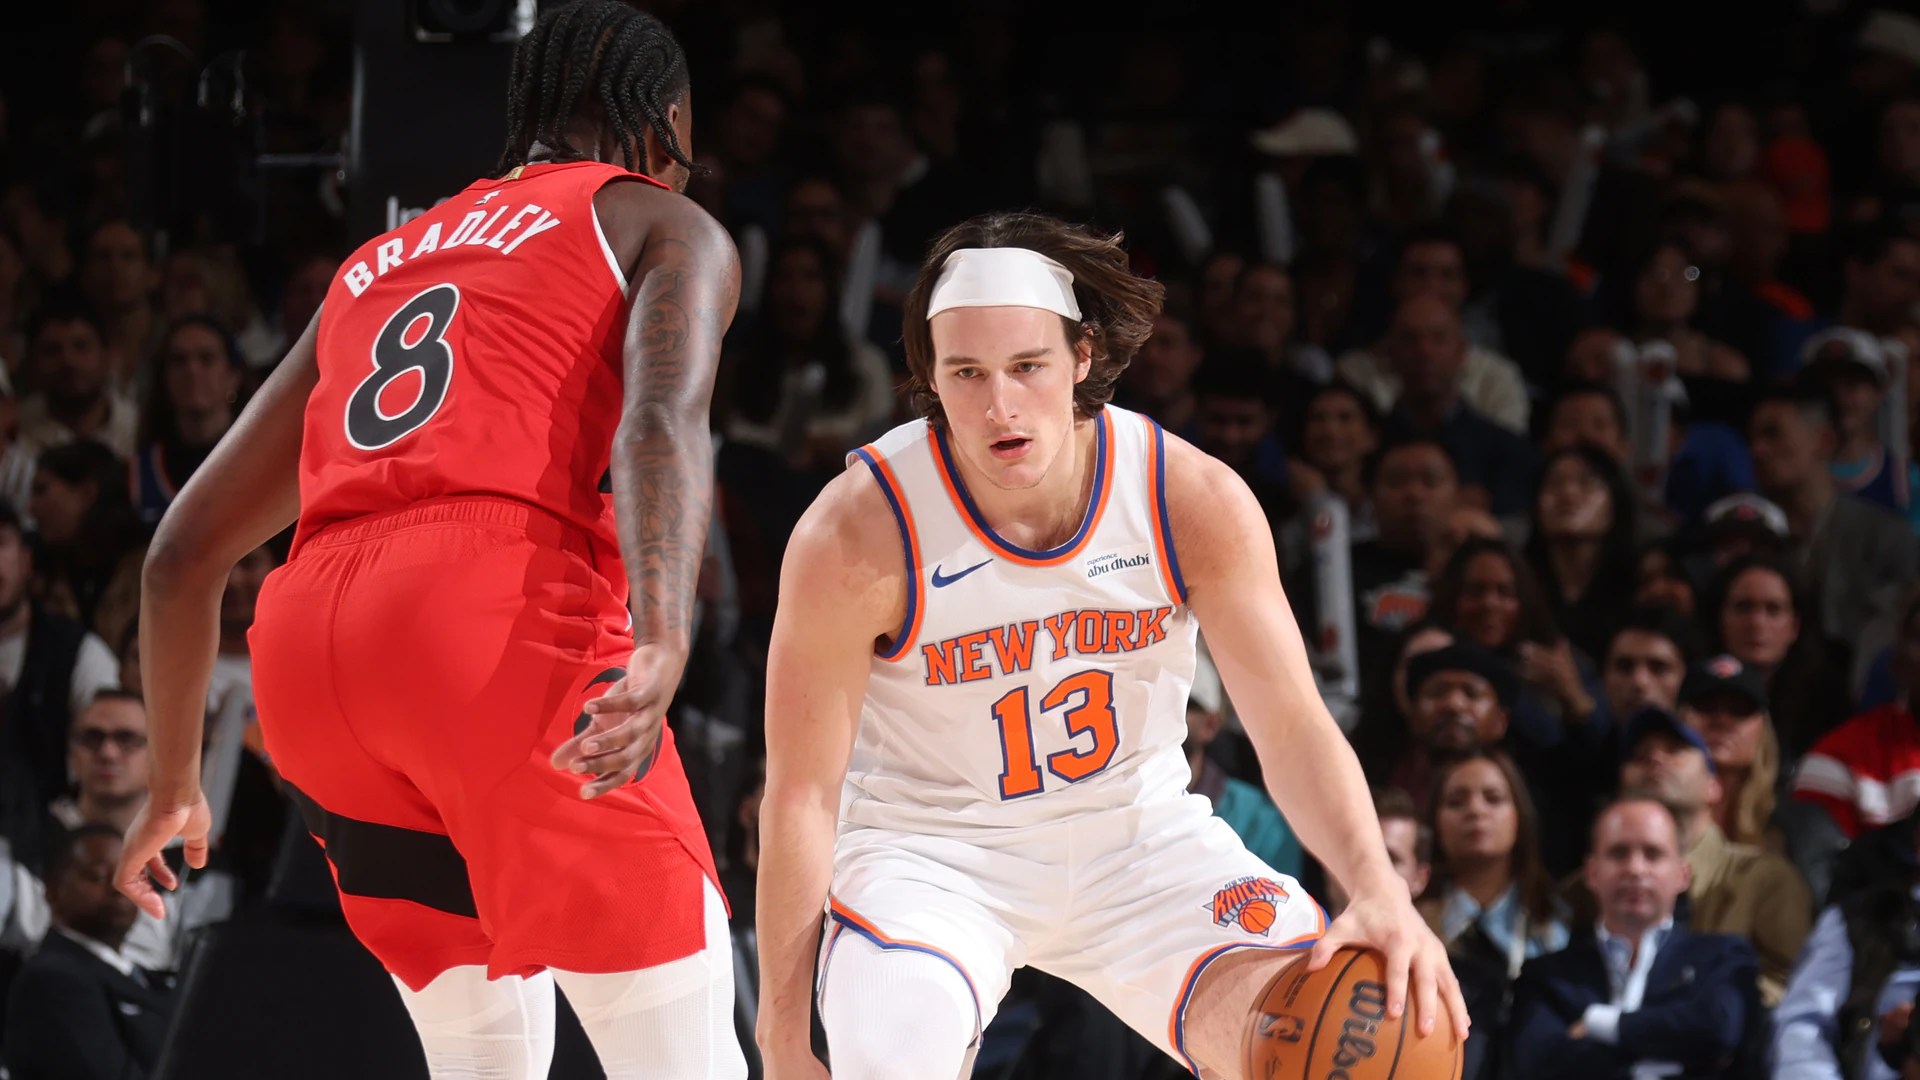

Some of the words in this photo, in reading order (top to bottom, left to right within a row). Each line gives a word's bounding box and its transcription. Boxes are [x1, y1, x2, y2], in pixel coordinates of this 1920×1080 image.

[343, 203, 561, 298] BRADLEY
[344, 282, 461, 451] 8
[1087, 552, 1118, 566] experience
[1087, 564, 1109, 578] abu
[922, 620, 1040, 686] NEW
[1043, 606, 1172, 662] YORK
[990, 668, 1120, 801] 13
[1213, 876, 1290, 925] KNICKS
